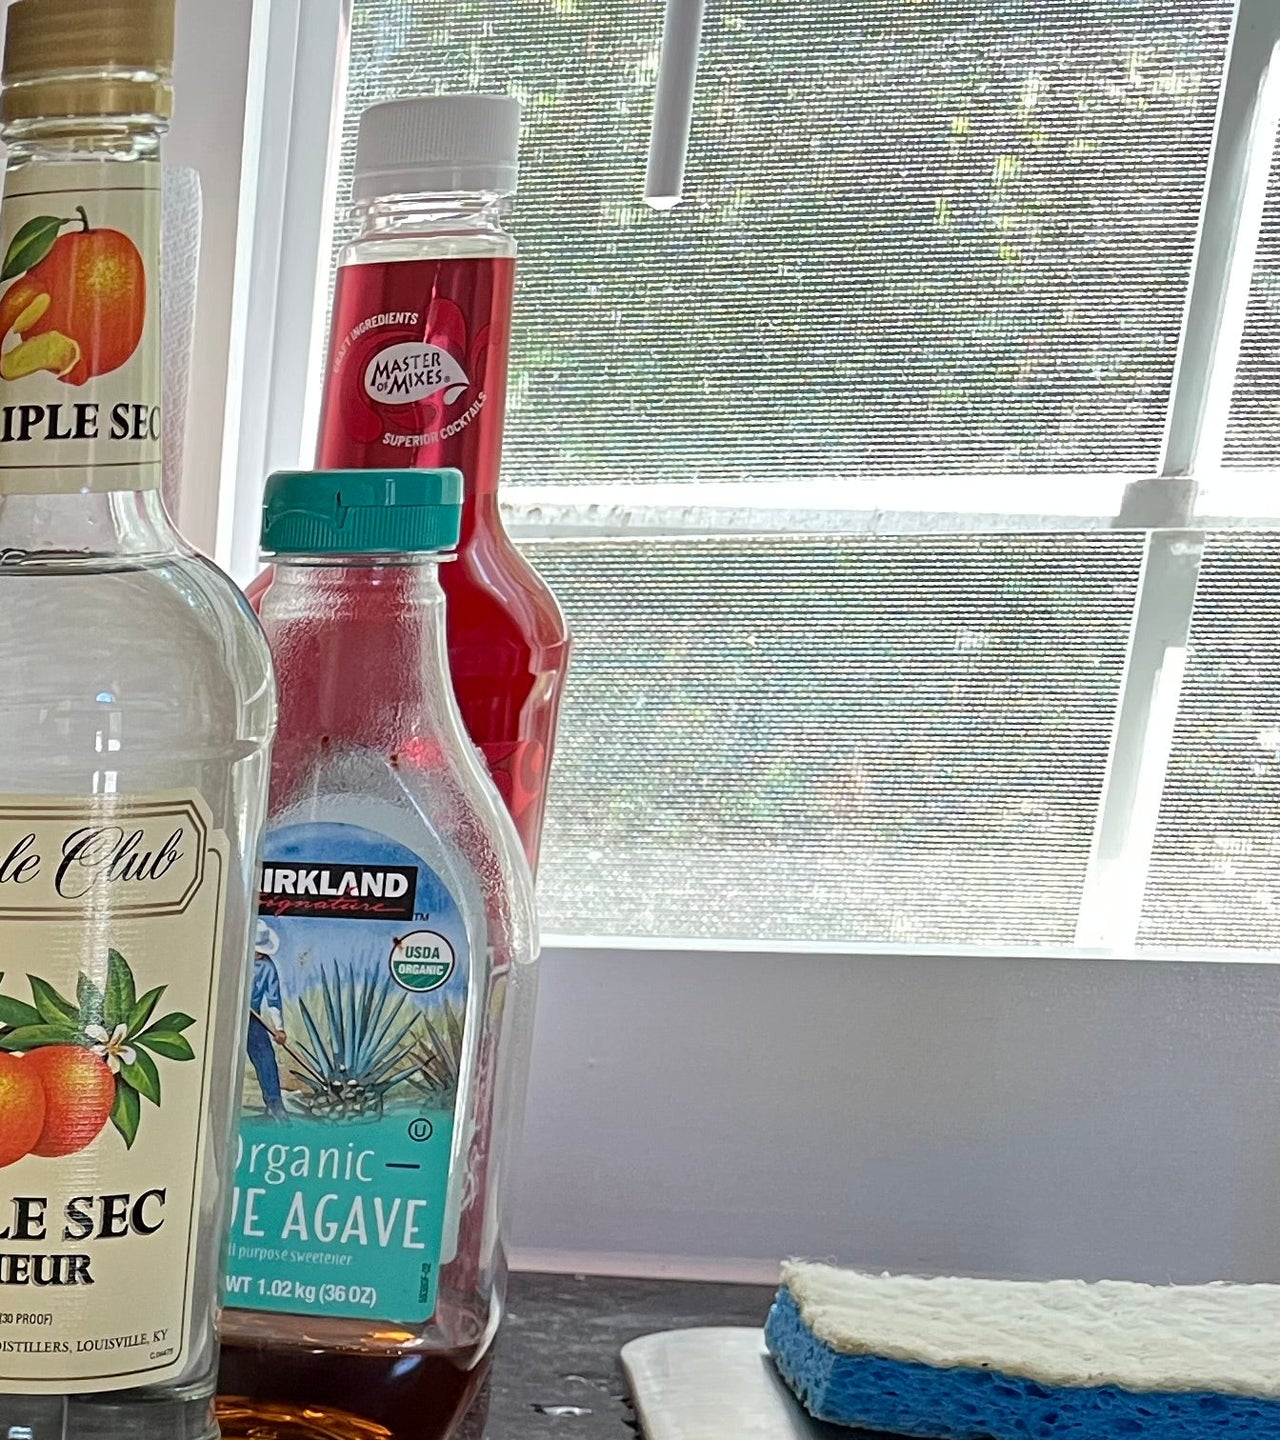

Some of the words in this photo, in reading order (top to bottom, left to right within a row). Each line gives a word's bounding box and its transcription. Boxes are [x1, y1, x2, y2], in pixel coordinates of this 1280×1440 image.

[350, 311, 419, 340] INGREDIENTS
[370, 352, 441, 387] MASTER
[387, 369, 442, 395] MIXES
[382, 431, 439, 448] SUPERIOR
[439, 390, 489, 440] COCKTAILS
[54, 826, 185, 900] Club
[260, 868, 409, 898] IRKLAND
[405, 946, 441, 961] USDA
[397, 962, 445, 977] ORGANIC
[61, 1187, 168, 1244] SEC
[280, 1190, 428, 1250] AGAVE
[238, 1245, 289, 1261] purpose
[290, 1249, 353, 1266] sweetener
[225, 1275, 253, 1294] WT
[257, 1278, 292, 1298] 1.02
[294, 1281, 316, 1304] kg
[319, 1283, 346, 1305] (36
[348, 1286, 378, 1308] OZ)
[15, 1312, 53, 1326] PROOF)
[76, 1332, 150, 1353] LOUISVILLE,
[152, 1328, 169, 1342] KY
